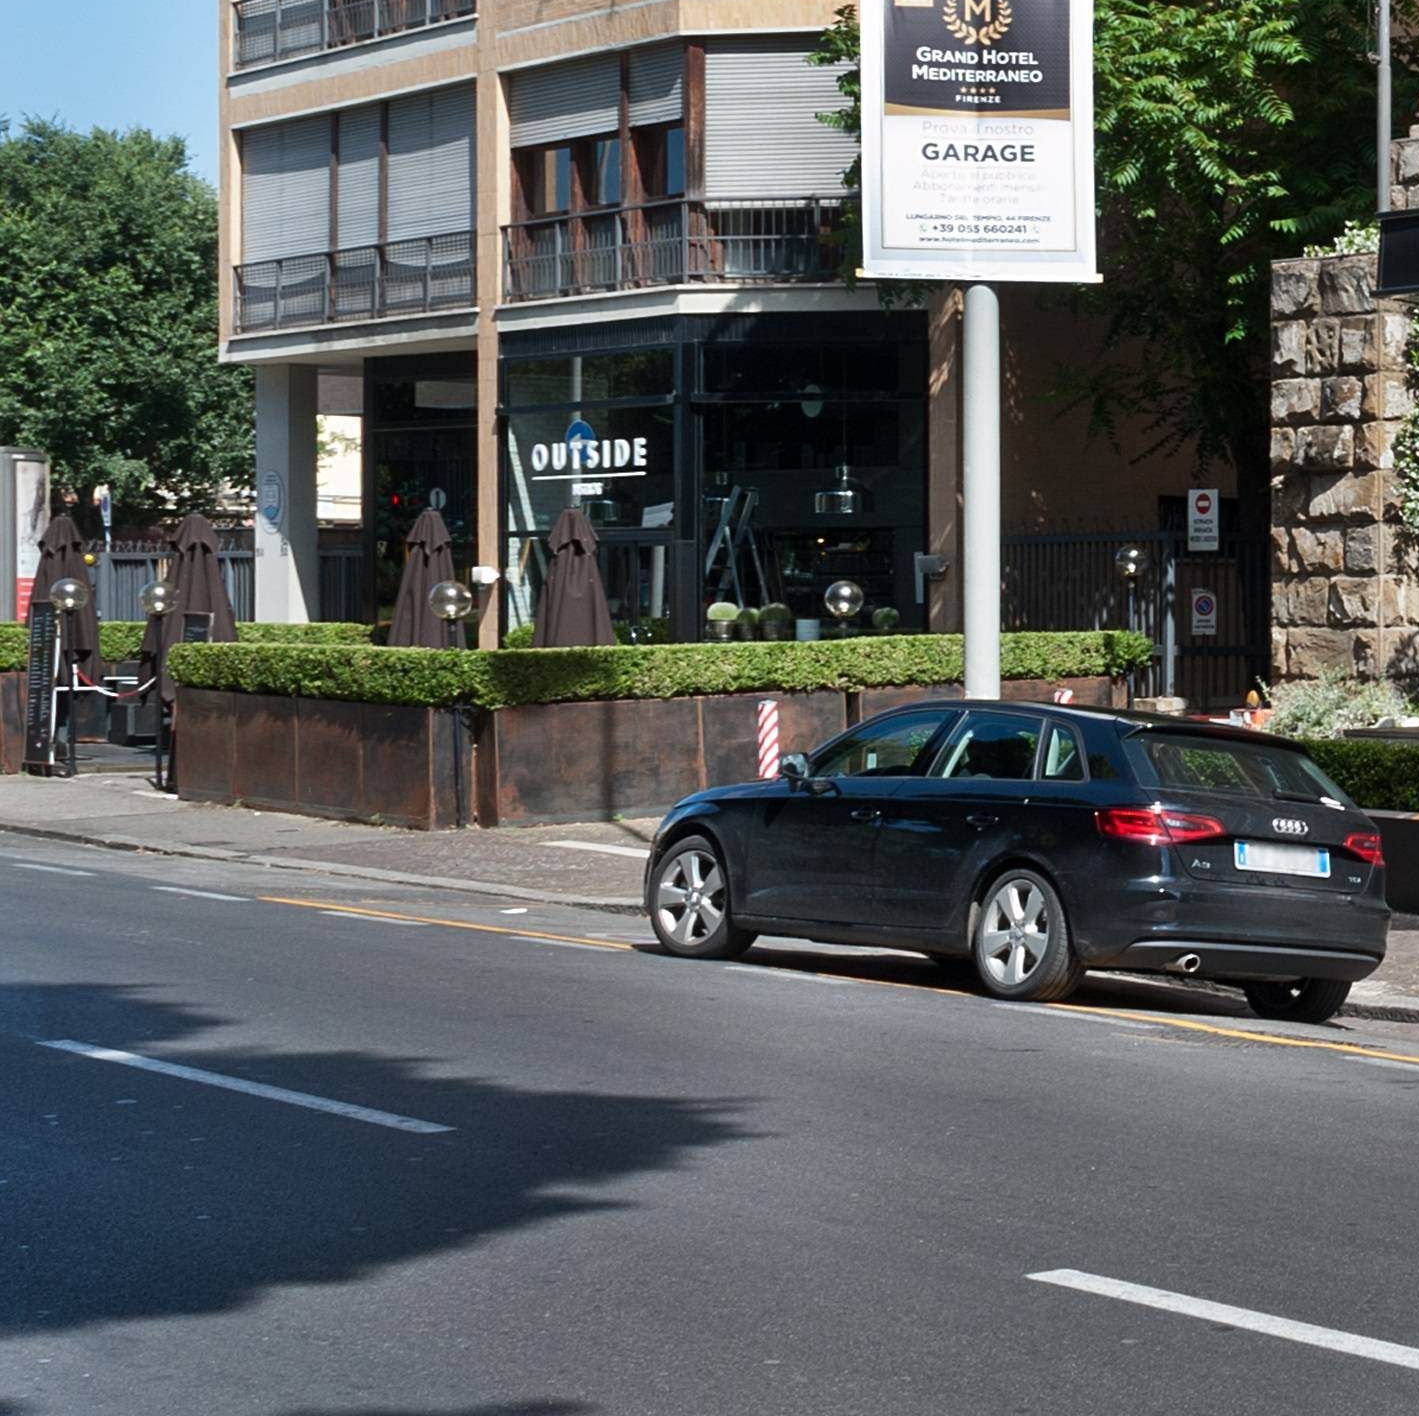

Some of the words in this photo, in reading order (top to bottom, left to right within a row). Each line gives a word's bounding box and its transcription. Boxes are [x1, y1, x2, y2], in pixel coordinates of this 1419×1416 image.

[916, 46, 979, 64] GRAND
[983, 49, 1039, 65] HOTEL
[912, 64, 1043, 83] MEDITERRANEO
[955, 95, 1001, 103] FIRENZE
[984, 123, 1035, 136] nostro
[921, 143, 1036, 162] GARAGE
[932, 224, 954, 233] +39
[957, 224, 980, 233] 055
[983, 224, 1028, 234] 660241
[531, 437, 648, 472] OUTSIDE
